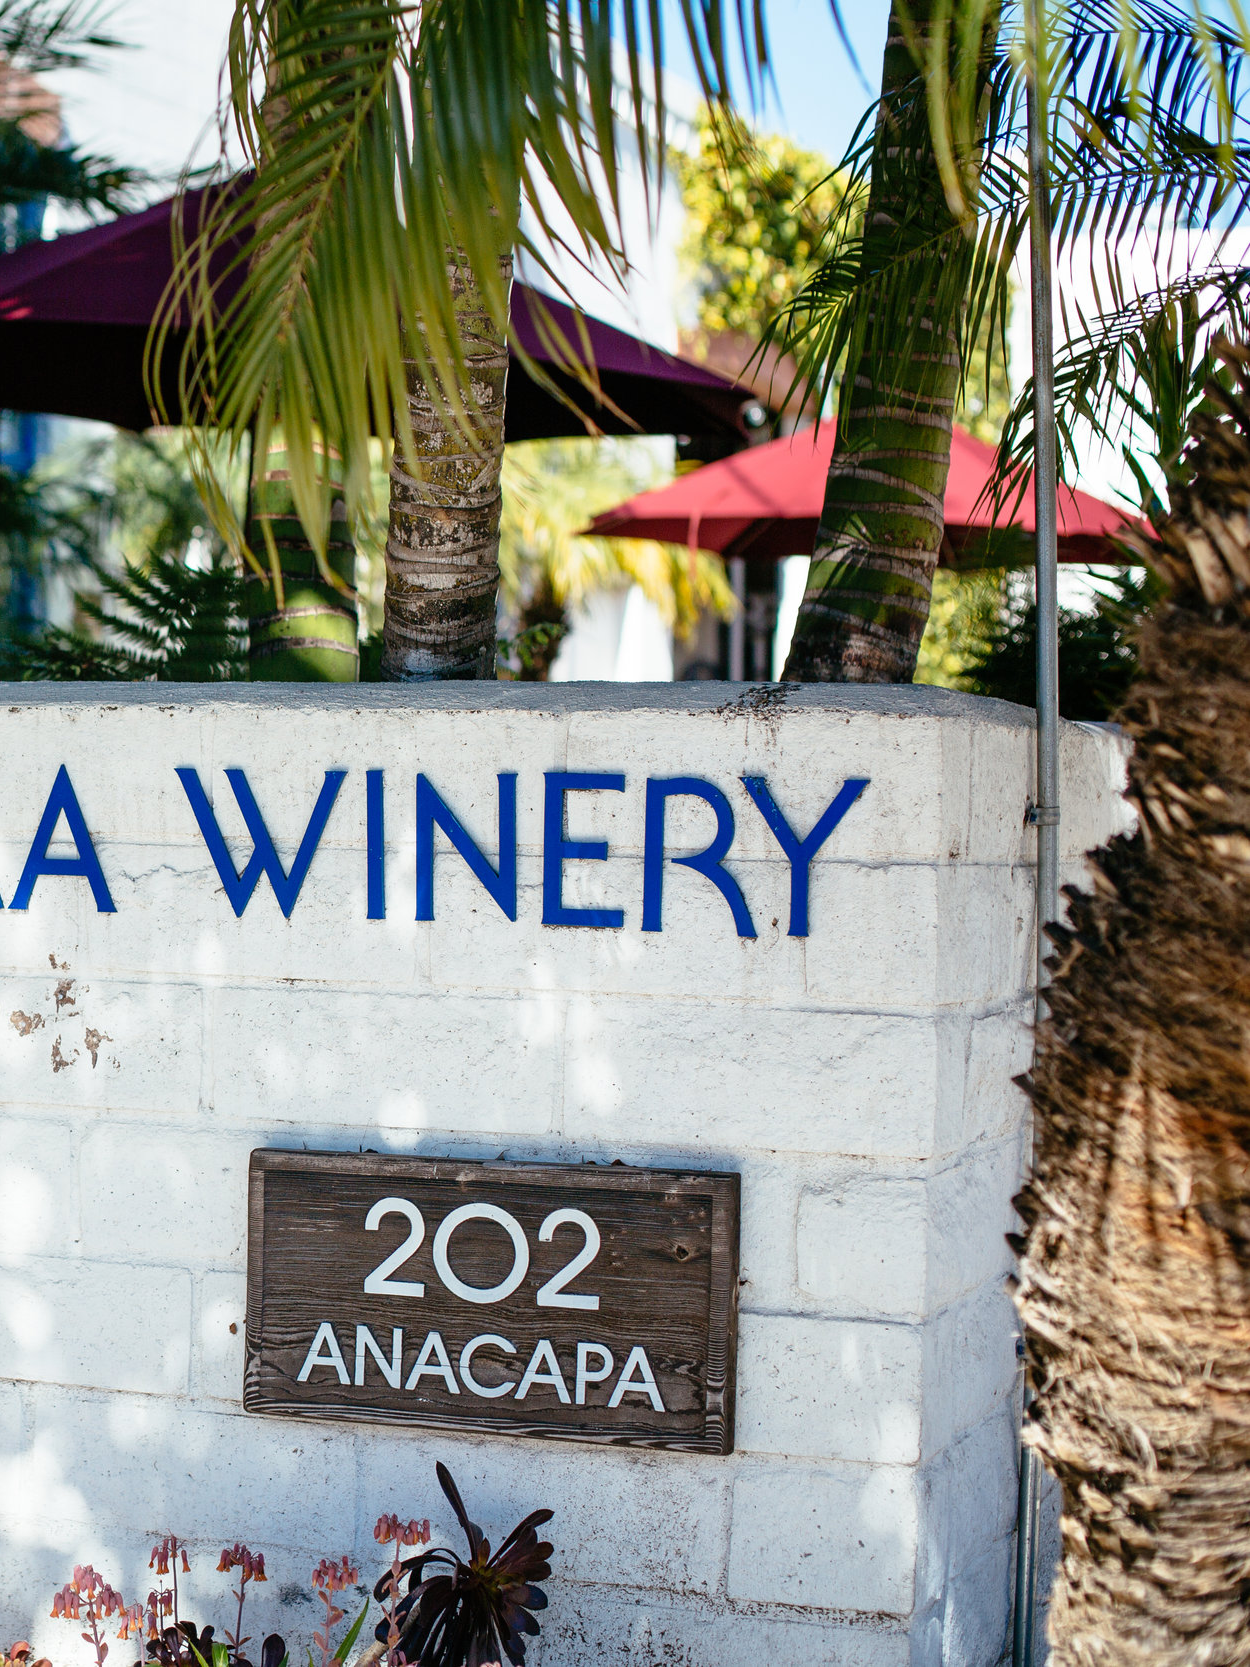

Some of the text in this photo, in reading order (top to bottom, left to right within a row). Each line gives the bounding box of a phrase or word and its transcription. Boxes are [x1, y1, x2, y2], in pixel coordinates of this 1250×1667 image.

[174, 767, 871, 938] WINERY
[363, 1197, 601, 1311] 202
[296, 1322, 666, 1413] ANACAPA
